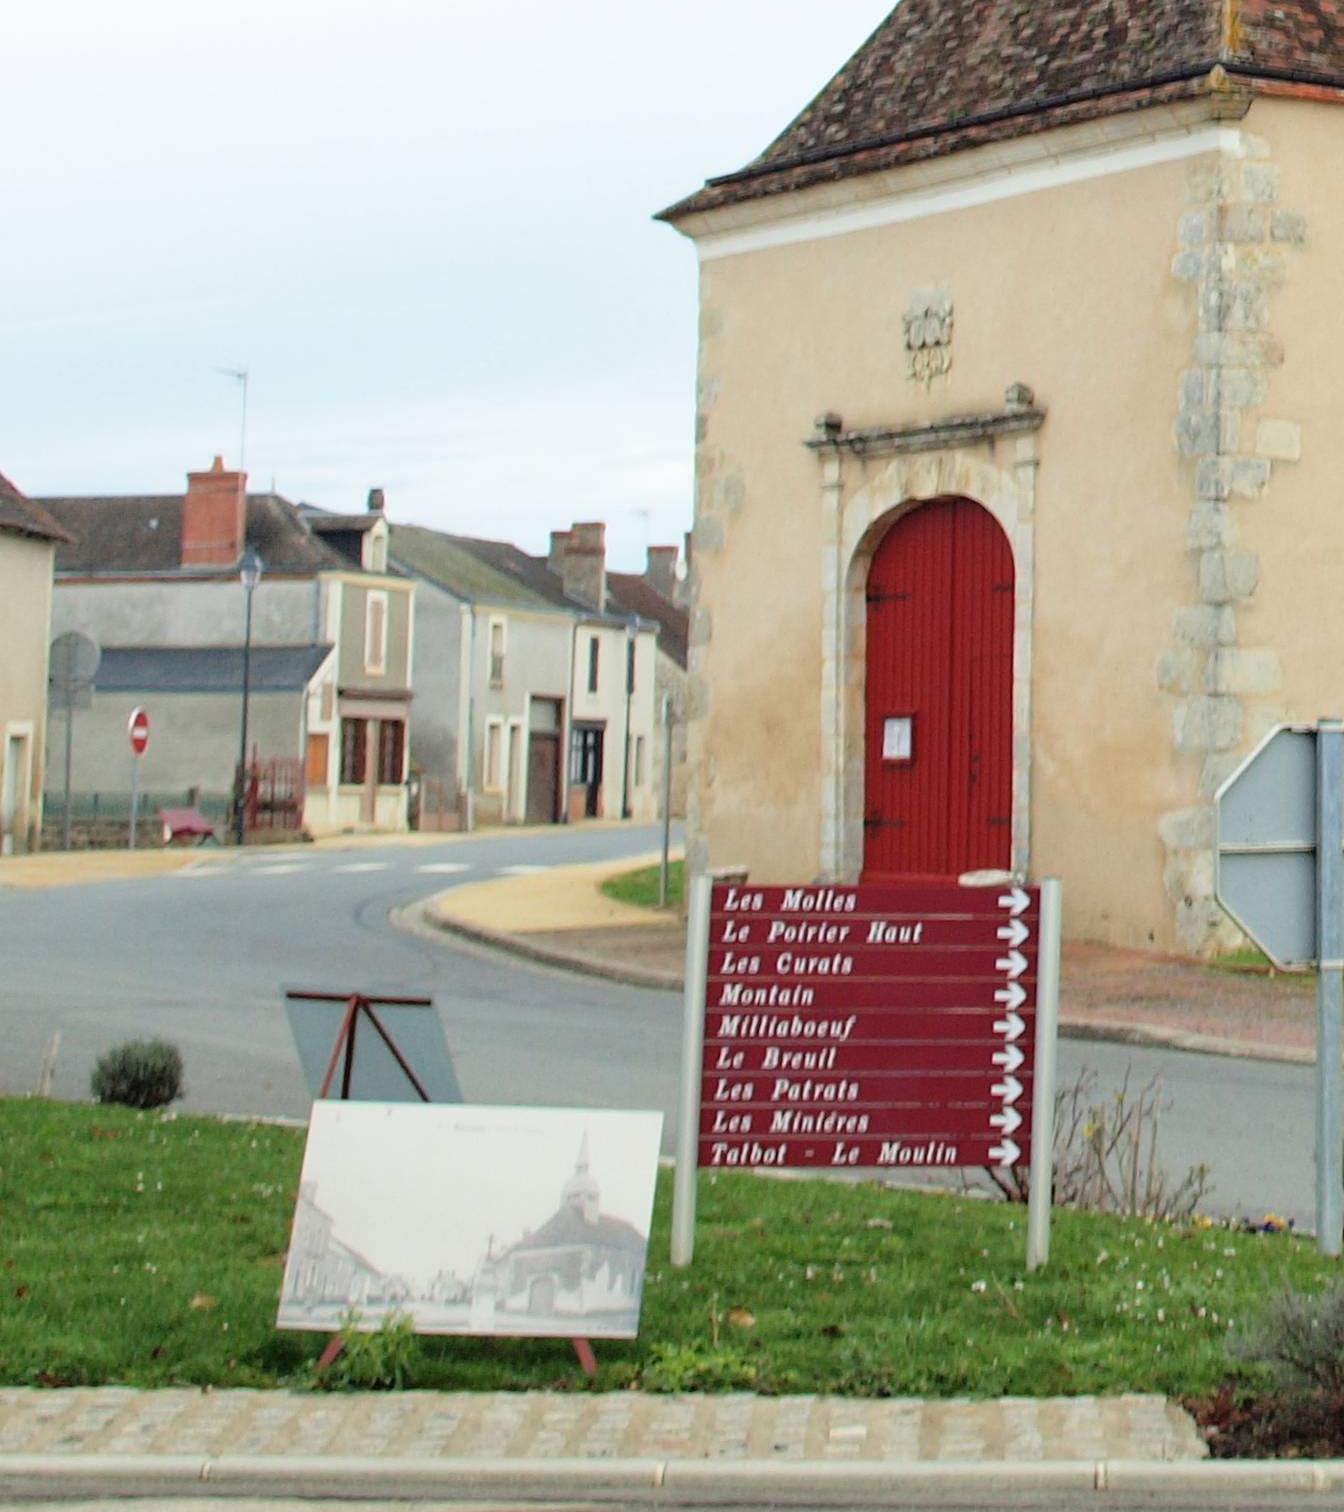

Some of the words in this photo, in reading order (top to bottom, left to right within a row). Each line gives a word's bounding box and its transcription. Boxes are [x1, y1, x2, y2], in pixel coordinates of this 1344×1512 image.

[724, 889, 763, 911] Les
[780, 890, 856, 912] Molles
[722, 921, 750, 942] Le
[767, 921, 849, 943] Poirier
[866, 922, 922, 944] Haut
[720, 952, 760, 974] Les
[776, 953, 853, 974] Curats
[719, 984, 814, 1006] Montain
[716, 1047, 744, 1069] Le
[762, 1047, 836, 1069] Breuil
[714, 1078, 754, 1101] Les
[771, 1079, 859, 1101] Patrats
[712, 1110, 751, 1133] Les
[711, 1142, 787, 1165] Talbot
[831, 1142, 860, 1165] Le
[876, 1141, 957, 1164] Moulin
